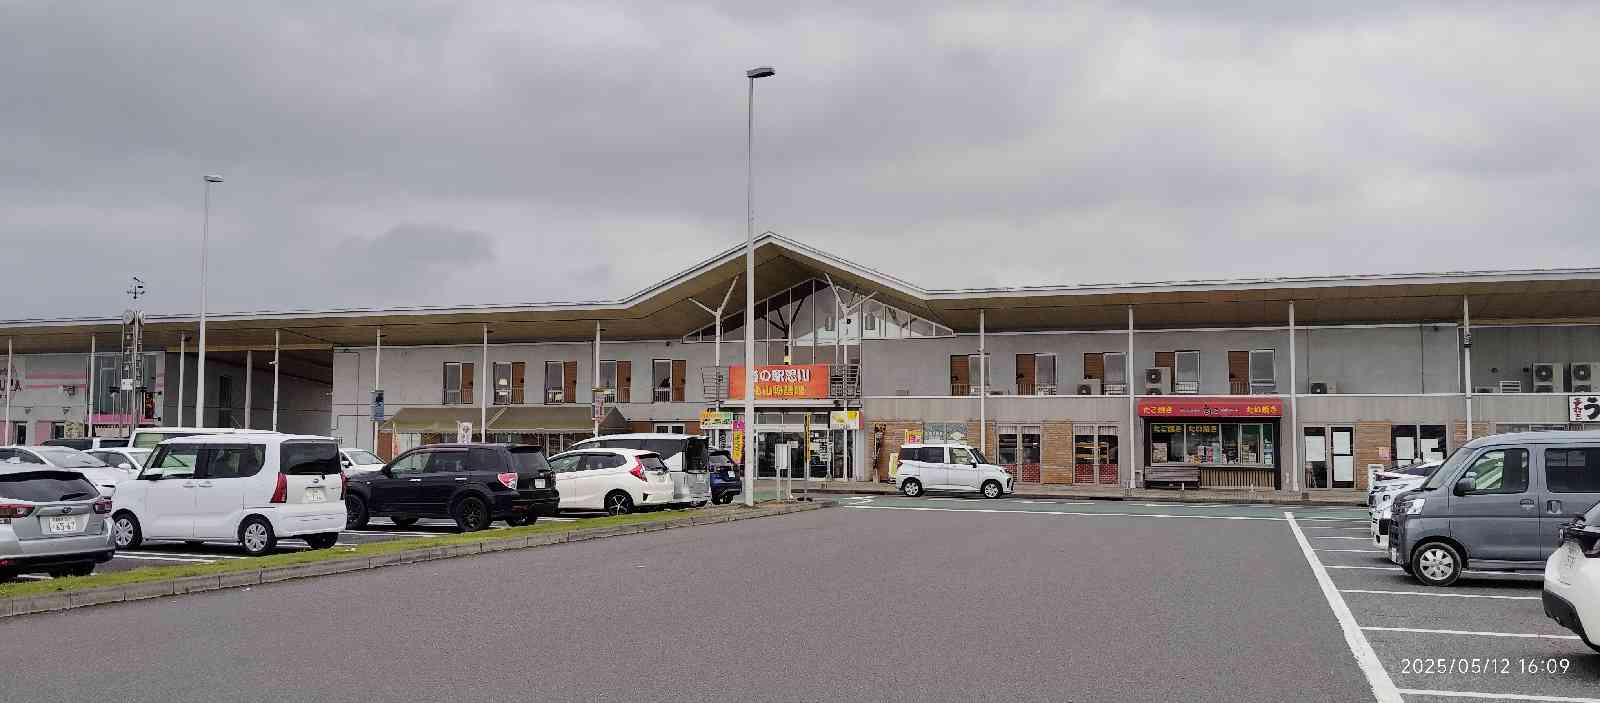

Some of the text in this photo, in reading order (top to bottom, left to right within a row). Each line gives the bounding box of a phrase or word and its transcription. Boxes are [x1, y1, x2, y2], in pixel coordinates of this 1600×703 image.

[1143, 406, 1173, 414] たこ焼き
[1247, 404, 1280, 414] たい焼き
[1153, 424, 1183, 433] たこ焼き
